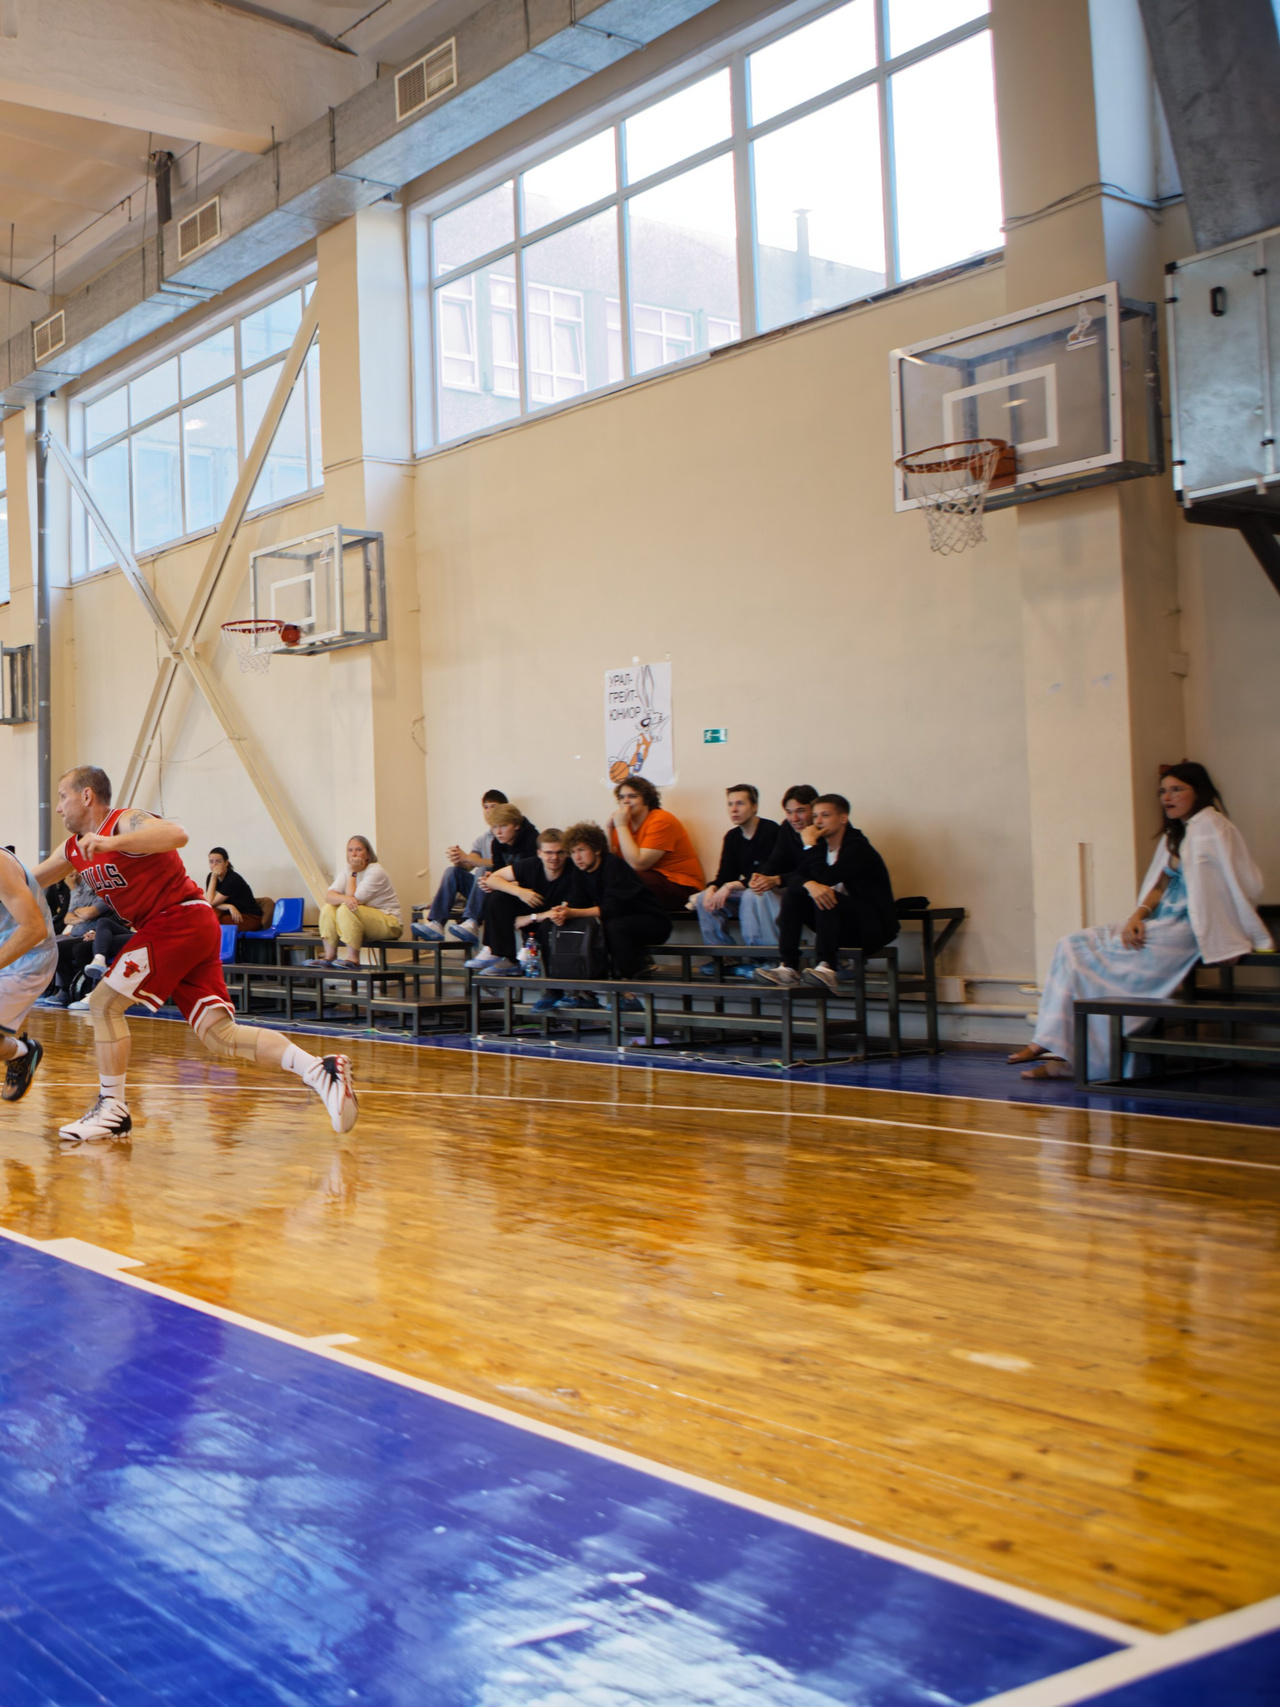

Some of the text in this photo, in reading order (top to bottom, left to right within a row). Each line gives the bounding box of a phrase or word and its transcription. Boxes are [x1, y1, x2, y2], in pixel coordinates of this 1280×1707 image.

[608, 673, 633, 687] УРАЛ-
[608, 688, 639, 704] ГРЕЙТ-
[608, 706, 641, 721] ЮНИОР
[80, 863, 128, 893] ULLS
